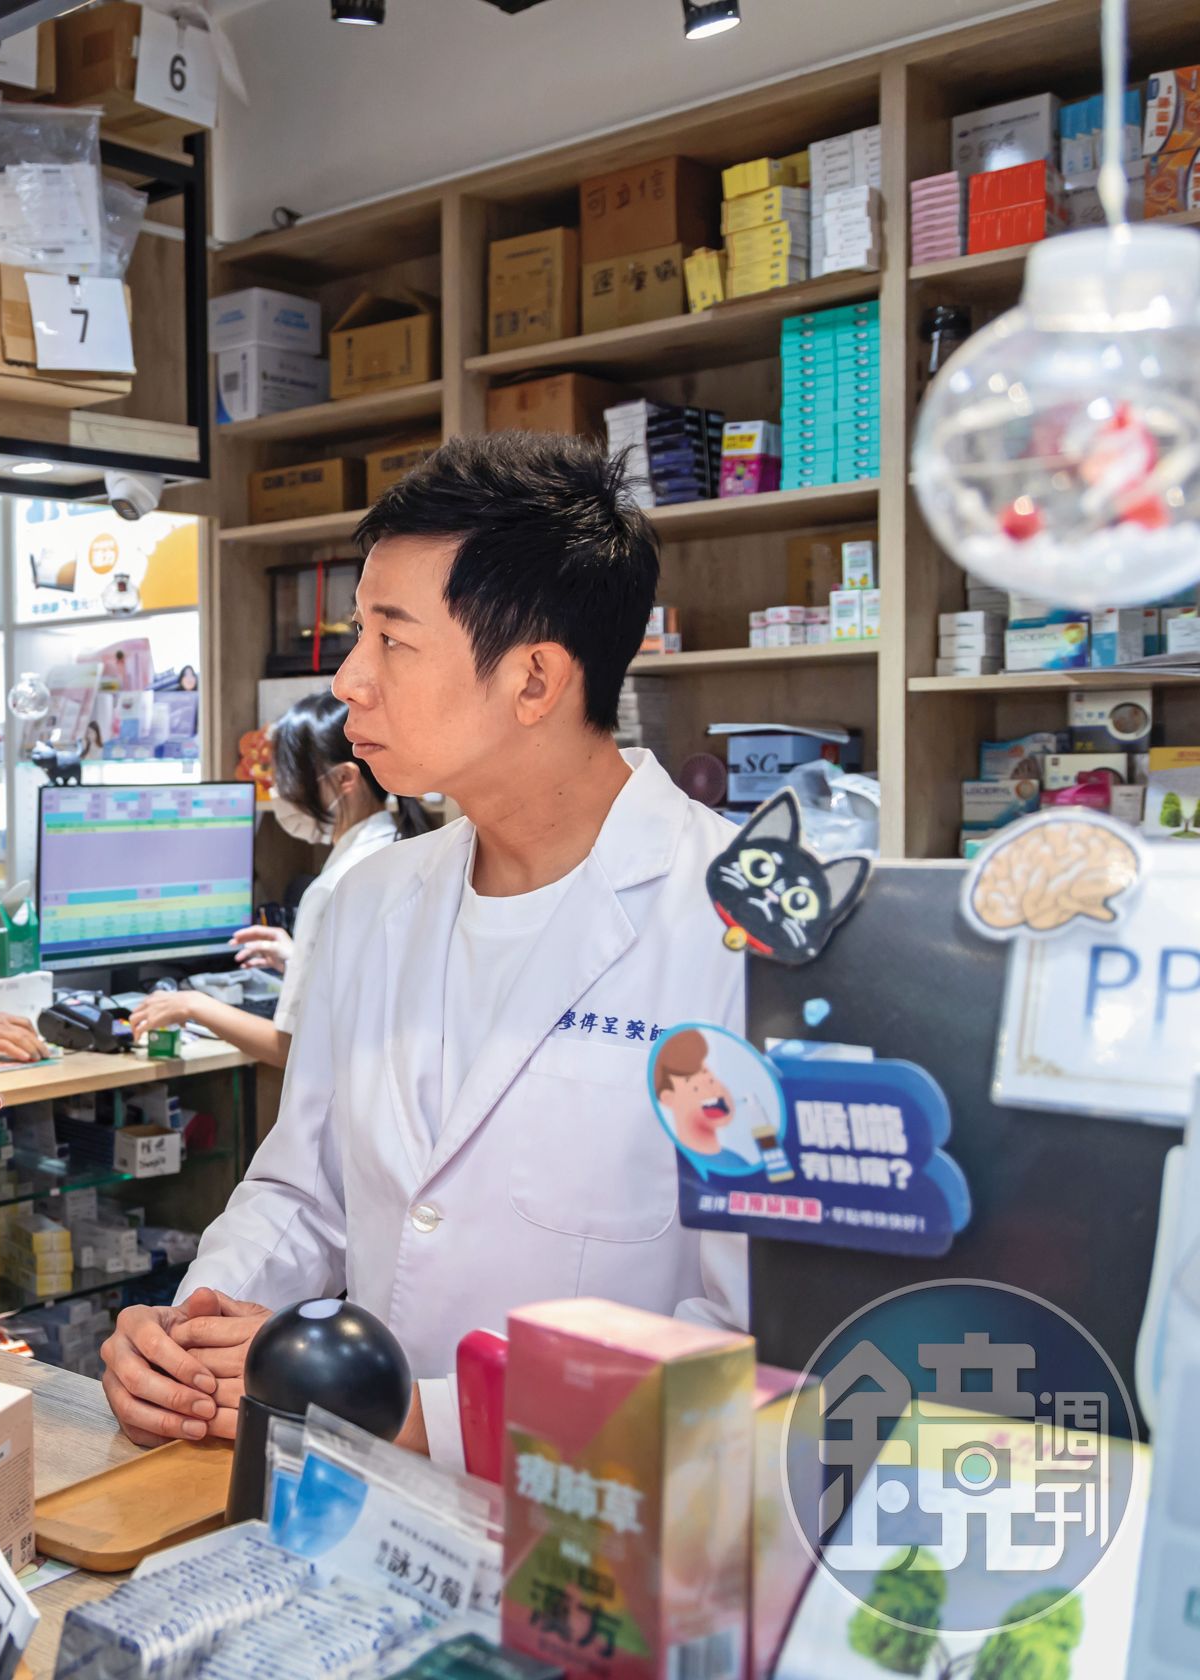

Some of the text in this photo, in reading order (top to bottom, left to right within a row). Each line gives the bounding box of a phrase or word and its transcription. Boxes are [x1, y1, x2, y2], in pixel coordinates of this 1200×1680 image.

[170, 54, 187, 92] 6
[71, 308, 88, 343] 7
[743, 752, 778, 774] SC
[795, 1100, 908, 1155] 喉嚨
